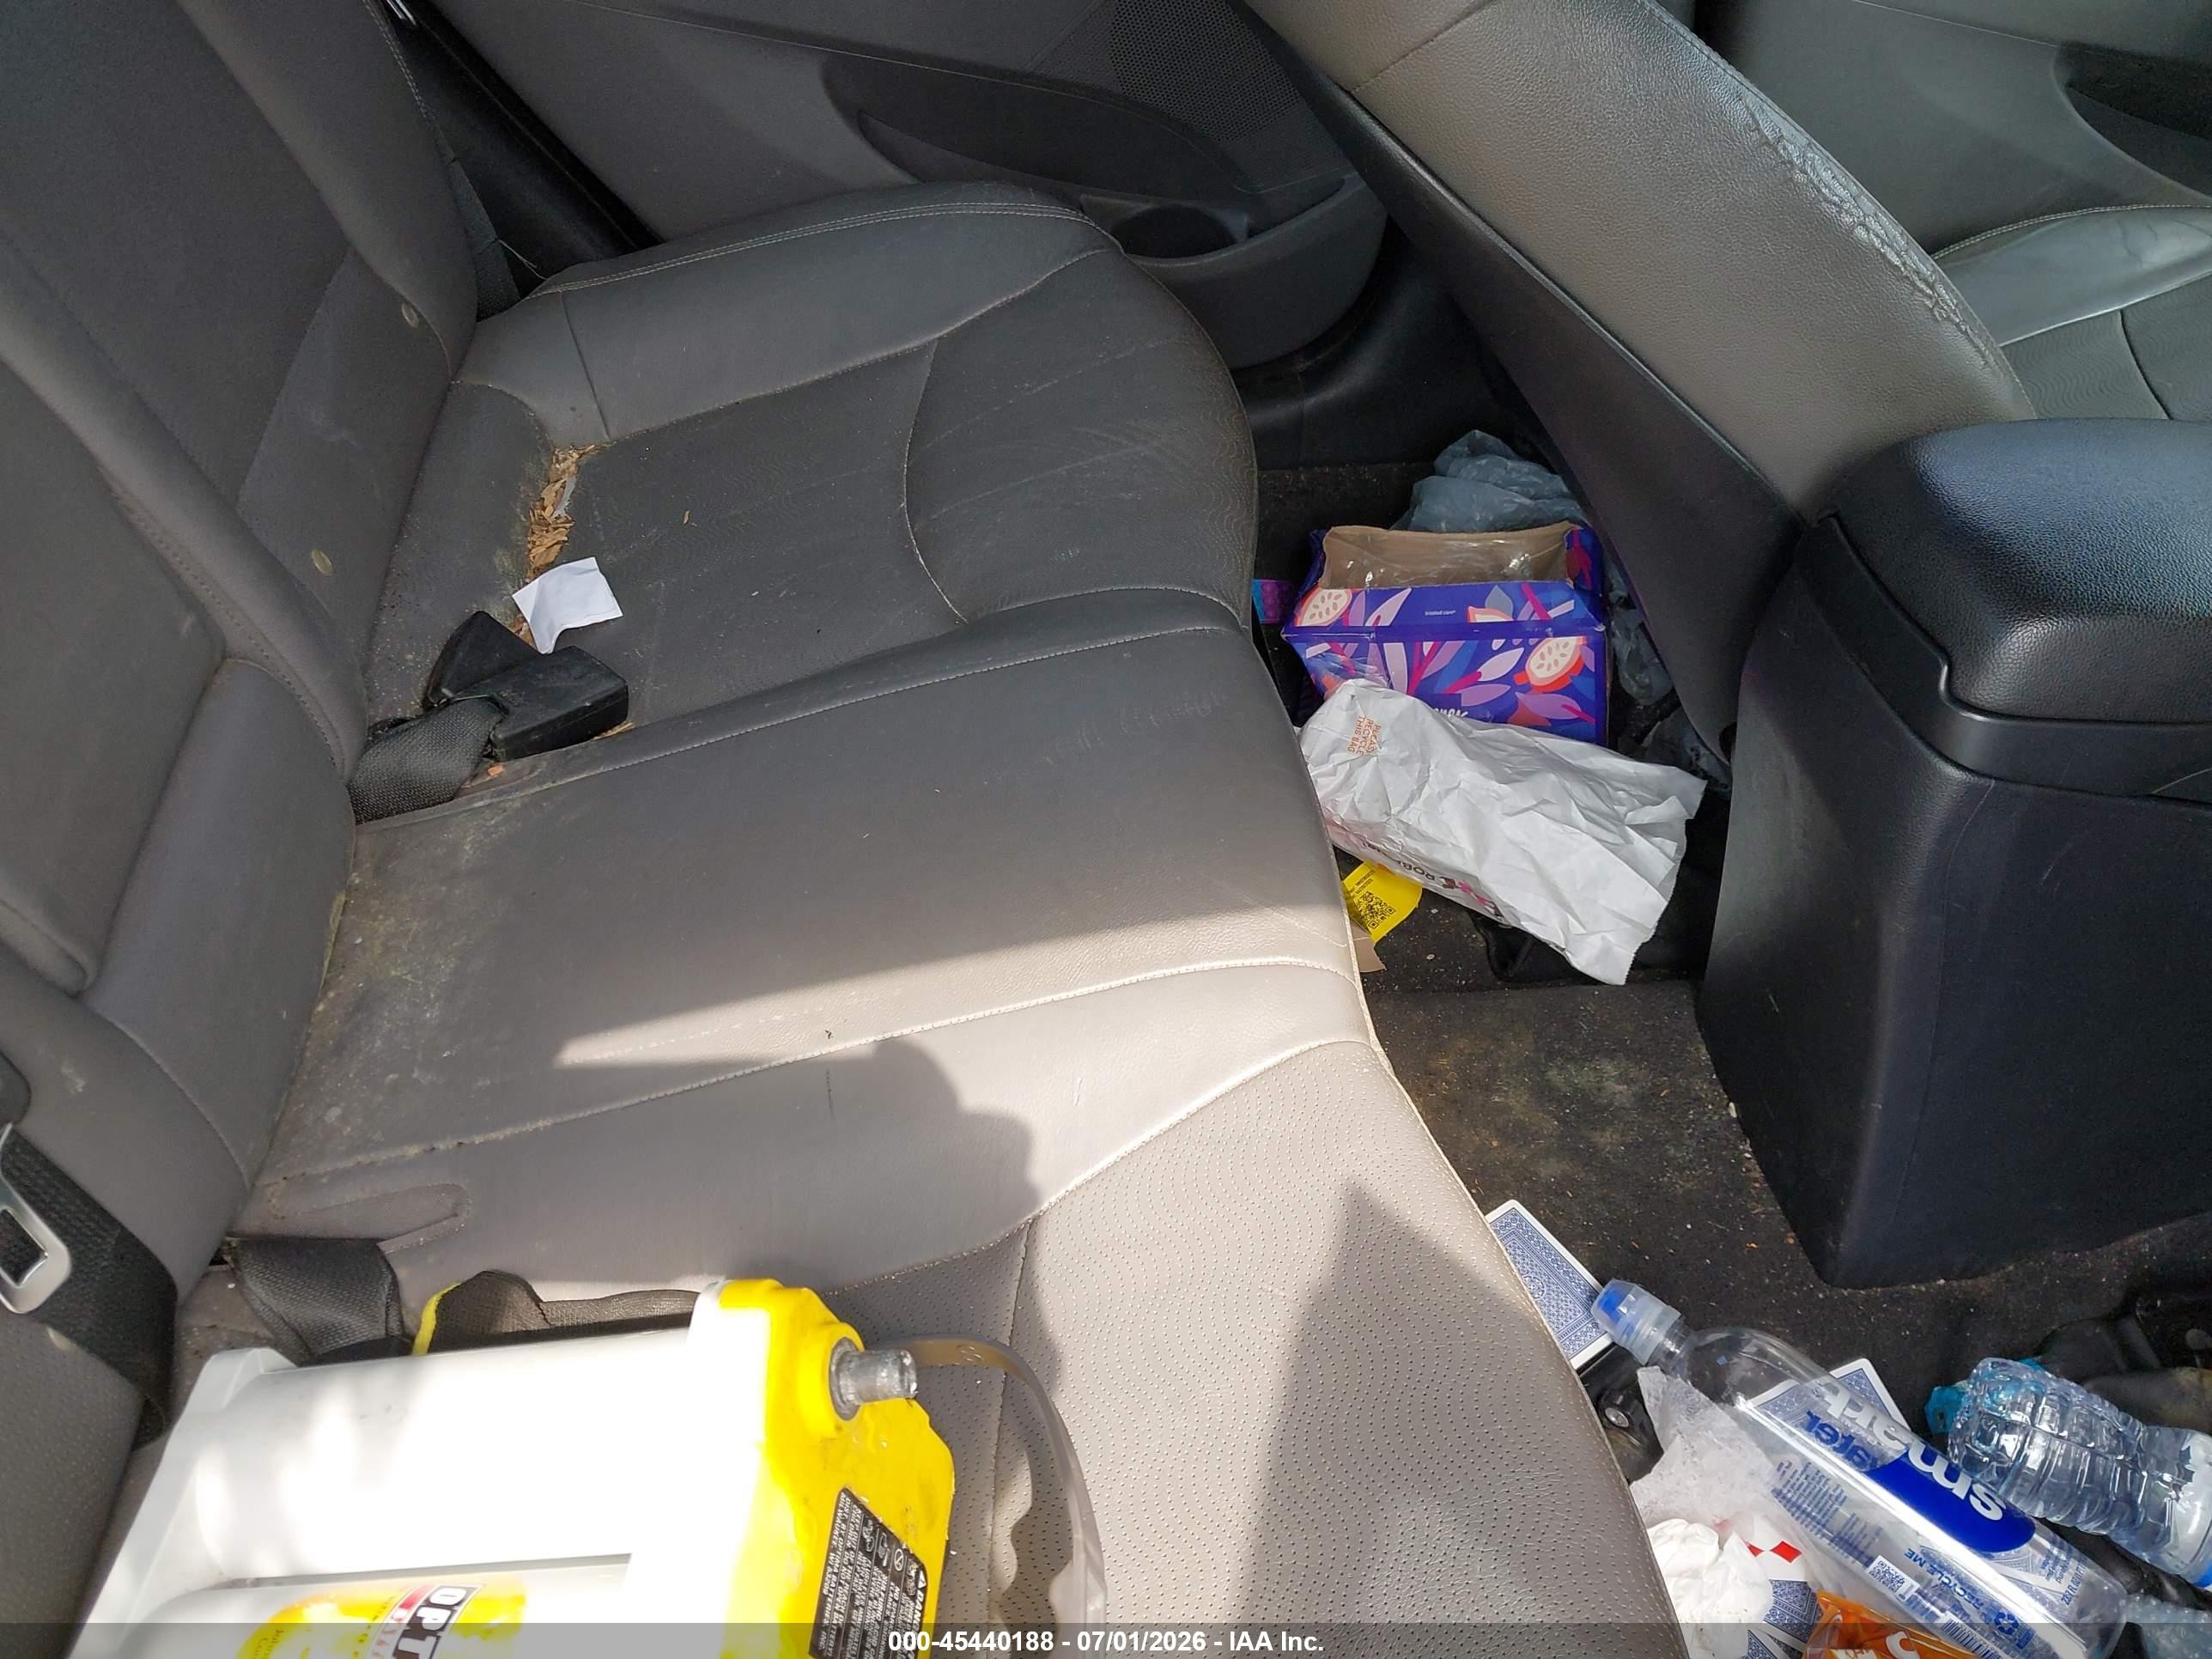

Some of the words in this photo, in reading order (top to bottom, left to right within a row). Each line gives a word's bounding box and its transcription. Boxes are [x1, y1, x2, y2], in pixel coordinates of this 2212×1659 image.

[1355, 715, 1366, 736] THIS
[1357, 718, 1374, 757] RECYCLE
[1366, 724, 1381, 754] PLEAS
[1347, 737, 1359, 753] BAG
[1814, 1380, 2007, 1522] smart
[833, 1537, 844, 1573] OPTIMA
[1904, 1547, 1927, 1568] ME
[1925, 1564, 1984, 1610] RECYCLE
[394, 1586, 469, 1659] OPT
